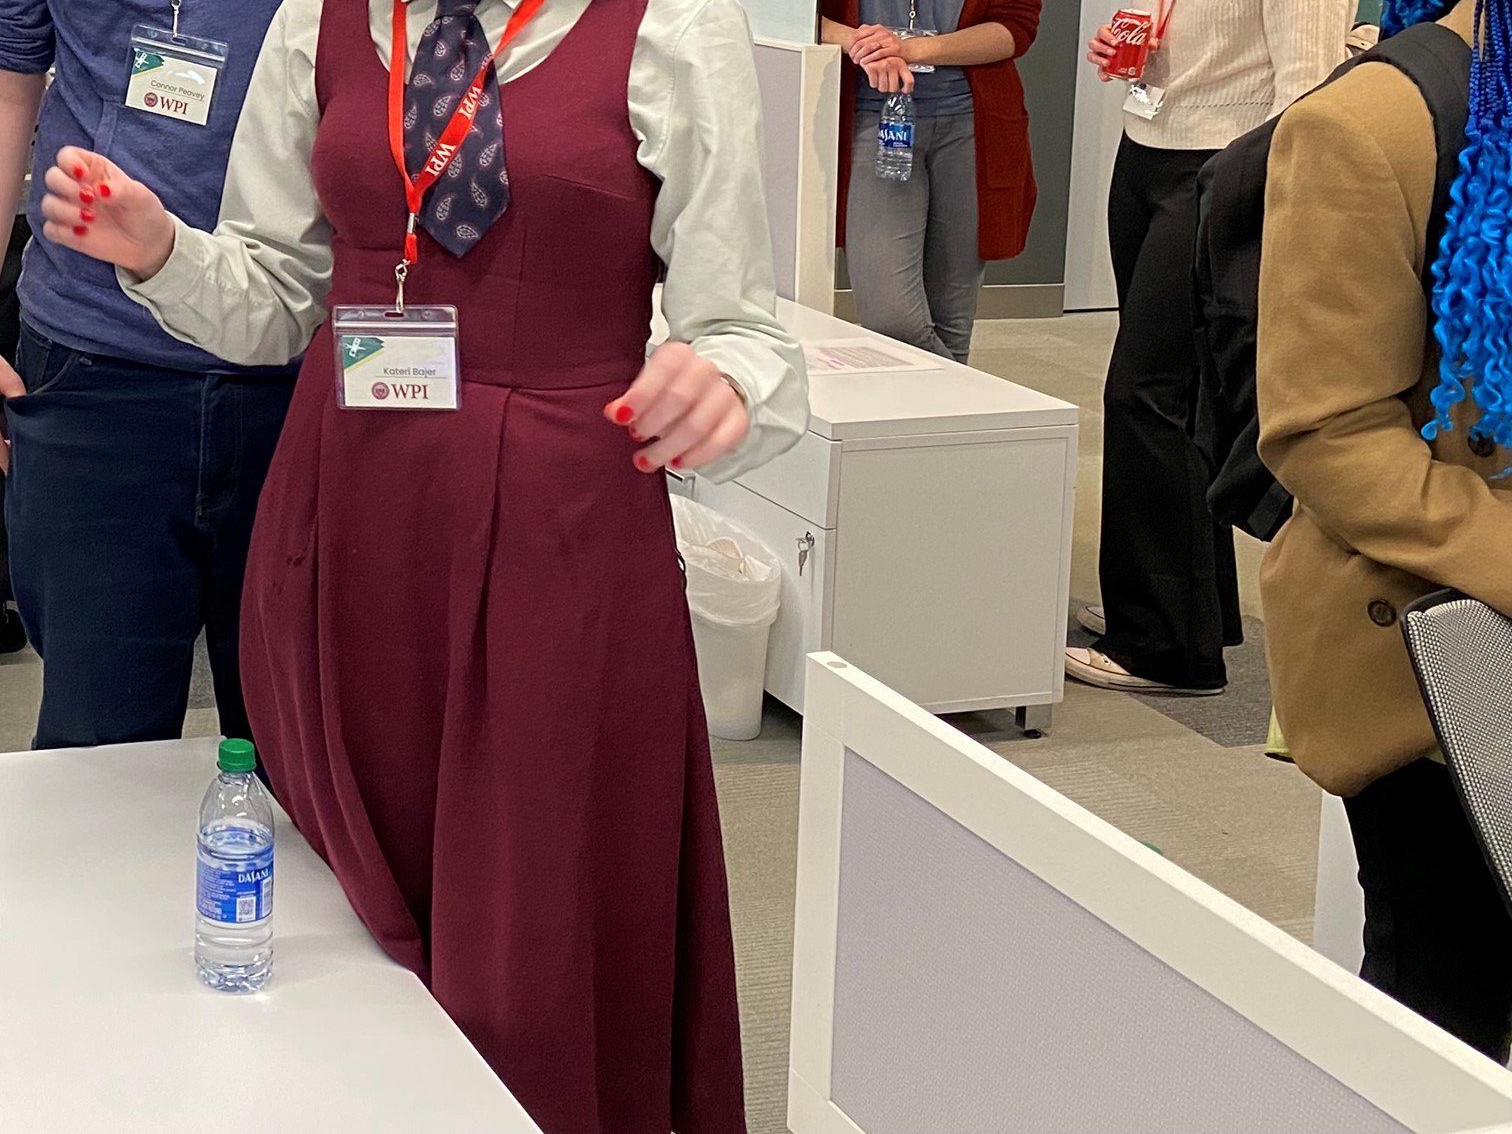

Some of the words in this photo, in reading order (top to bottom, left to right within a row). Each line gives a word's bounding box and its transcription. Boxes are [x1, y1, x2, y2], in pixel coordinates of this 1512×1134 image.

[1111, 18, 1152, 46] Cola
[150, 79, 179, 93] Connor
[178, 86, 205, 102] Peavey
[160, 95, 189, 116] WPI
[458, 84, 482, 121] WPI
[879, 128, 907, 142] ASANI
[424, 142, 456, 178] WPI
[383, 366, 411, 376] Kateri
[412, 367, 437, 379] Bajer
[390, 383, 429, 400] WPI
